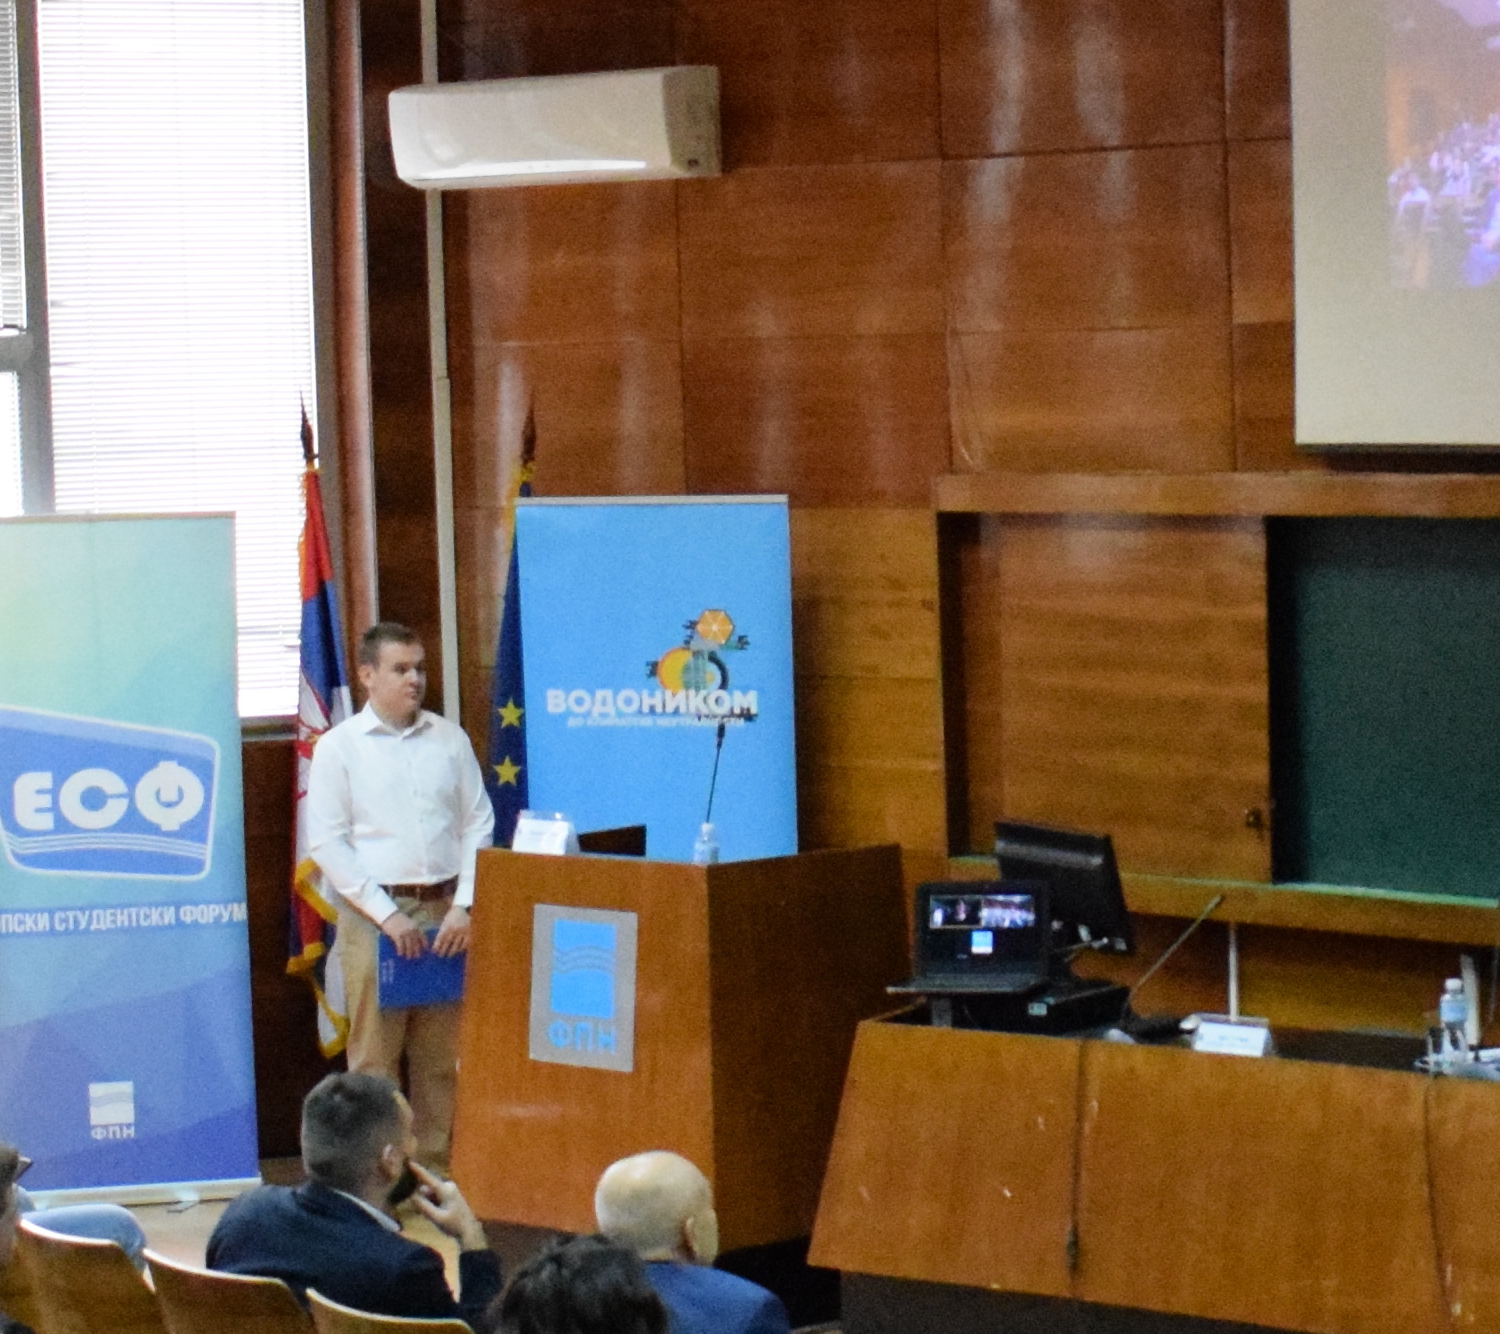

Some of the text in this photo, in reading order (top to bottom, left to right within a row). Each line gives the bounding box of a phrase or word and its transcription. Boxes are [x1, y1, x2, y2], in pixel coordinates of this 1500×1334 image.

[546, 688, 758, 715] ВОДОНИКОМ
[13, 760, 205, 831] ЕСФ
[54, 906, 176, 931] СТУДЕНТСКИ
[180, 902, 248, 925] ФОРУМ
[546, 1019, 617, 1055] ФПН
[90, 1125, 135, 1140] ФПН
